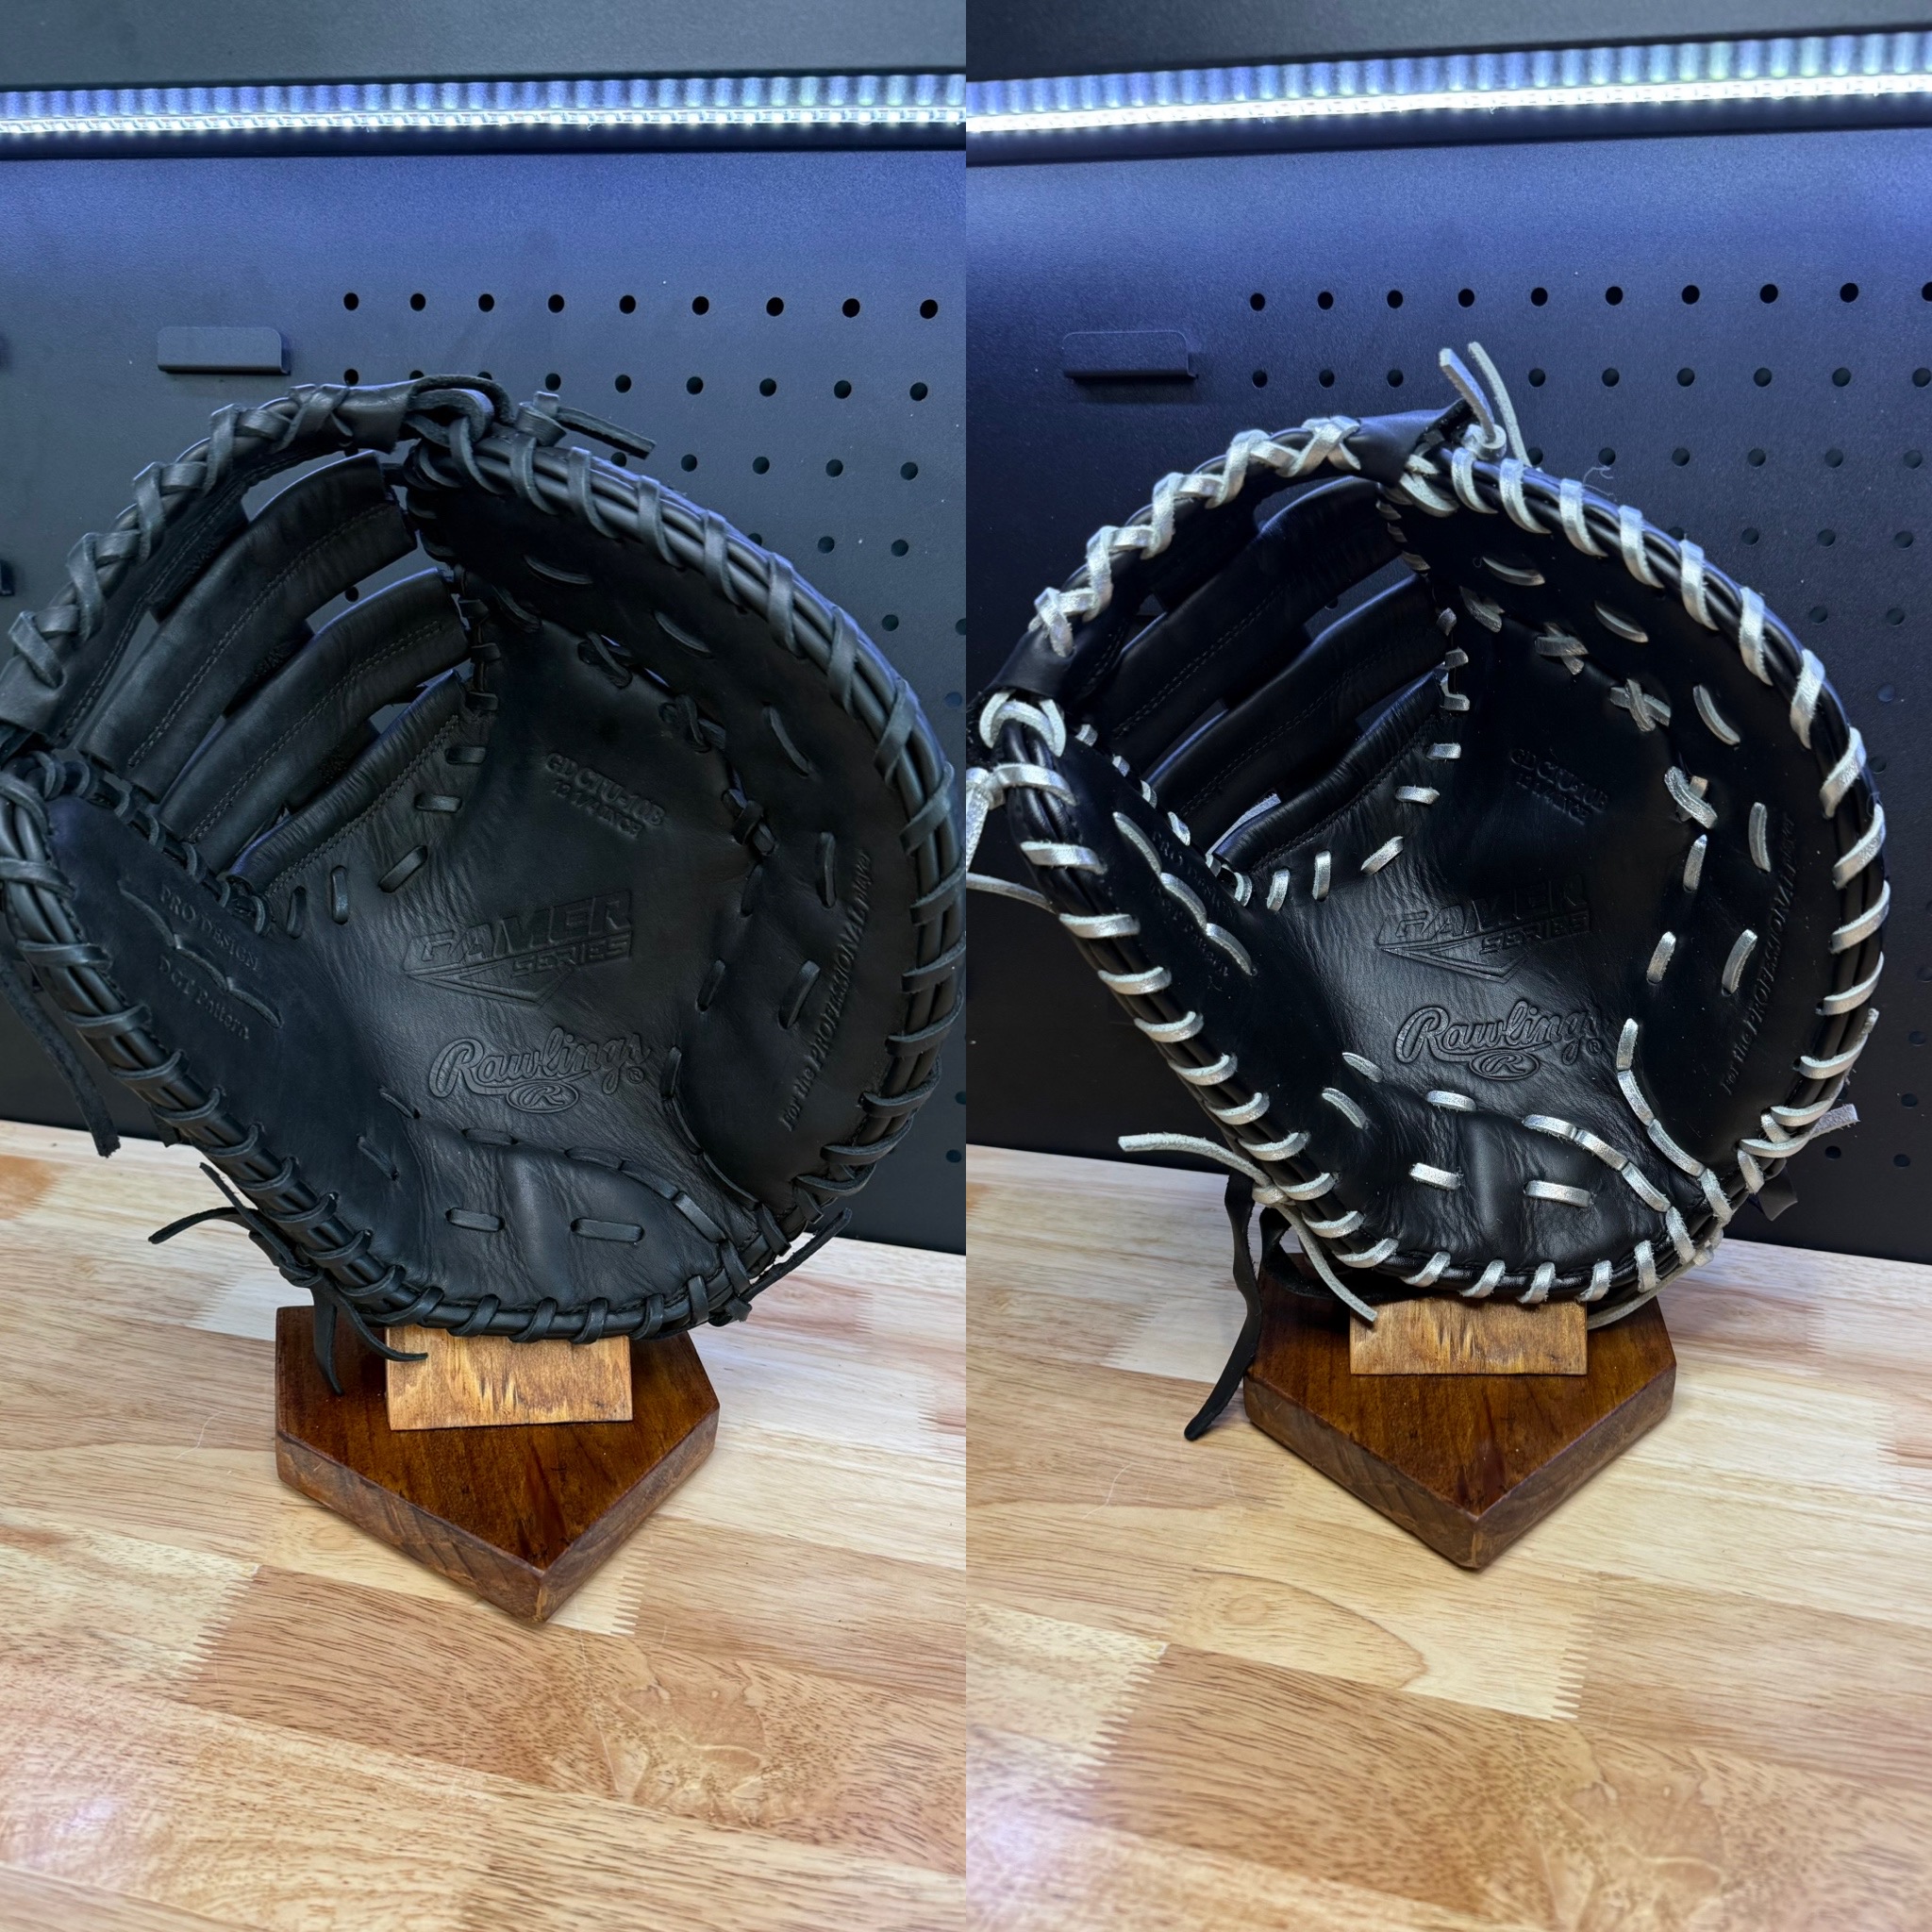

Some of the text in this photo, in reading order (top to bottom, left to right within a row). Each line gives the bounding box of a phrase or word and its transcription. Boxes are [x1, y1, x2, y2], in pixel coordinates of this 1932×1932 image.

[158, 884, 259, 972] PRO DESIGN
[404, 890, 632, 972] GAMER
[510, 930, 632, 978] SERIES
[1479, 908, 1589, 956] SERIES
[193, 988, 252, 1041] Pattern
[803, 905, 868, 1071] PROFESSIONAL
[428, 1025, 651, 1098] Rawlings
[791, 1064, 816, 1099] the
